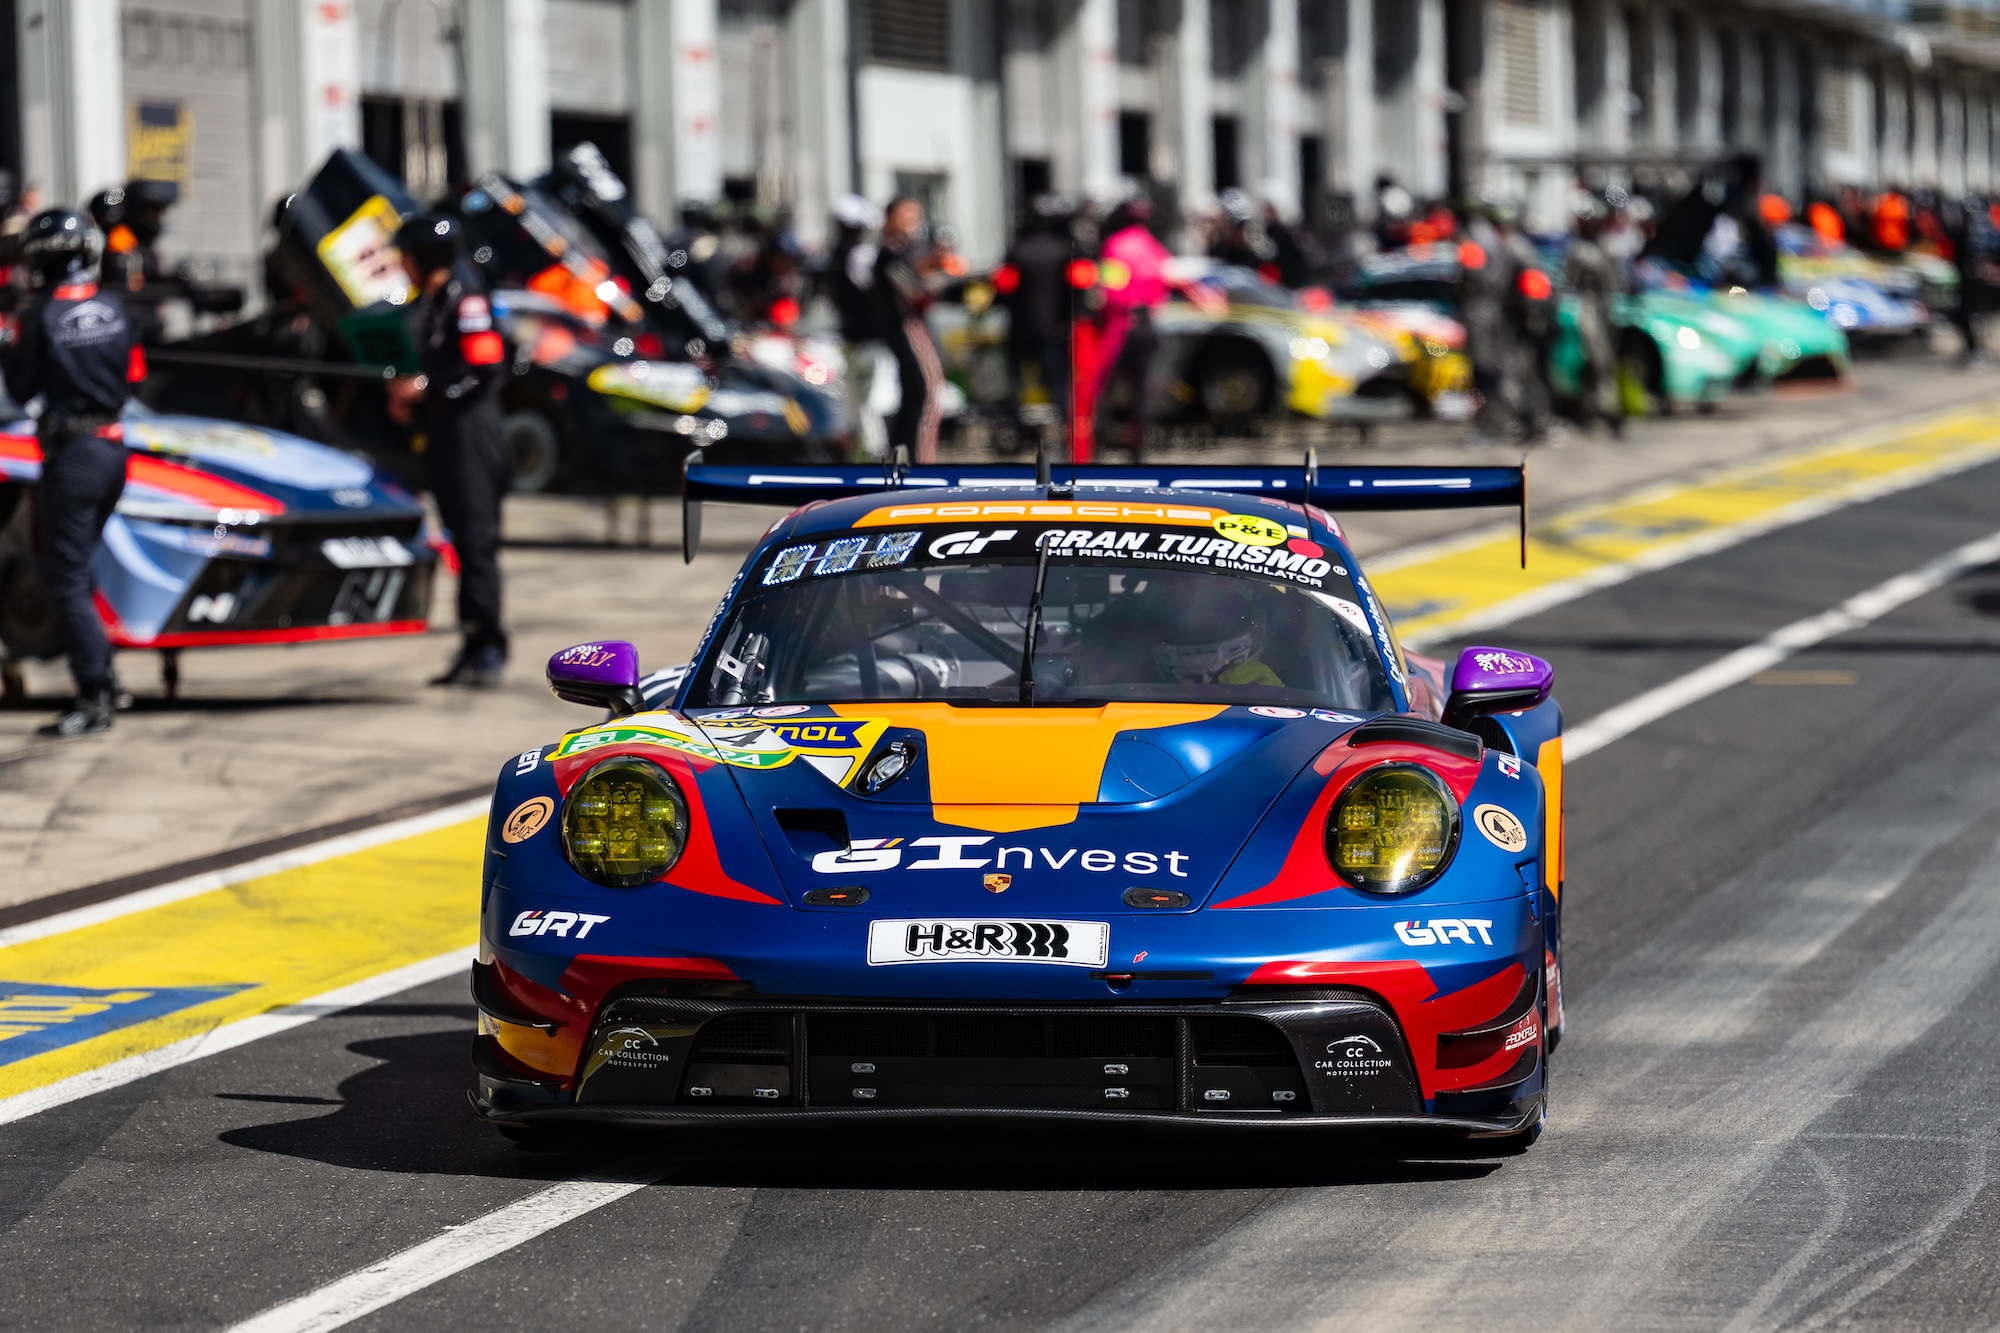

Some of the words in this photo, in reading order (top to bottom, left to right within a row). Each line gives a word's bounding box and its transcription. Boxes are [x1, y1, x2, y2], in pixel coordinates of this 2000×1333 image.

[890, 506, 1211, 520] PORSCHE
[1034, 529, 1150, 551] GRAN
[1158, 534, 1332, 578] TURISMO
[1079, 549, 1127, 559] REAL
[1132, 551, 1210, 565] DRIVING
[1215, 558, 1323, 588] SIMULATOR
[630, 732, 761, 766] DEKRA
[508, 910, 611, 939] GRT
[905, 922, 1013, 957] H&R
[1393, 918, 1494, 947] GRT
[624, 1038, 641, 1050] CC
[598, 1048, 614, 1057] CAR
[616, 1050, 669, 1062] COLLECTION
[1345, 1047, 1364, 1058] CC
[608, 1059, 658, 1069] MOTORSPORT
[1314, 1060, 1333, 1069] CAR
[1336, 1059, 1392, 1068] COLLECTION
[1326, 1069, 1380, 1077] MOTORSPORT
